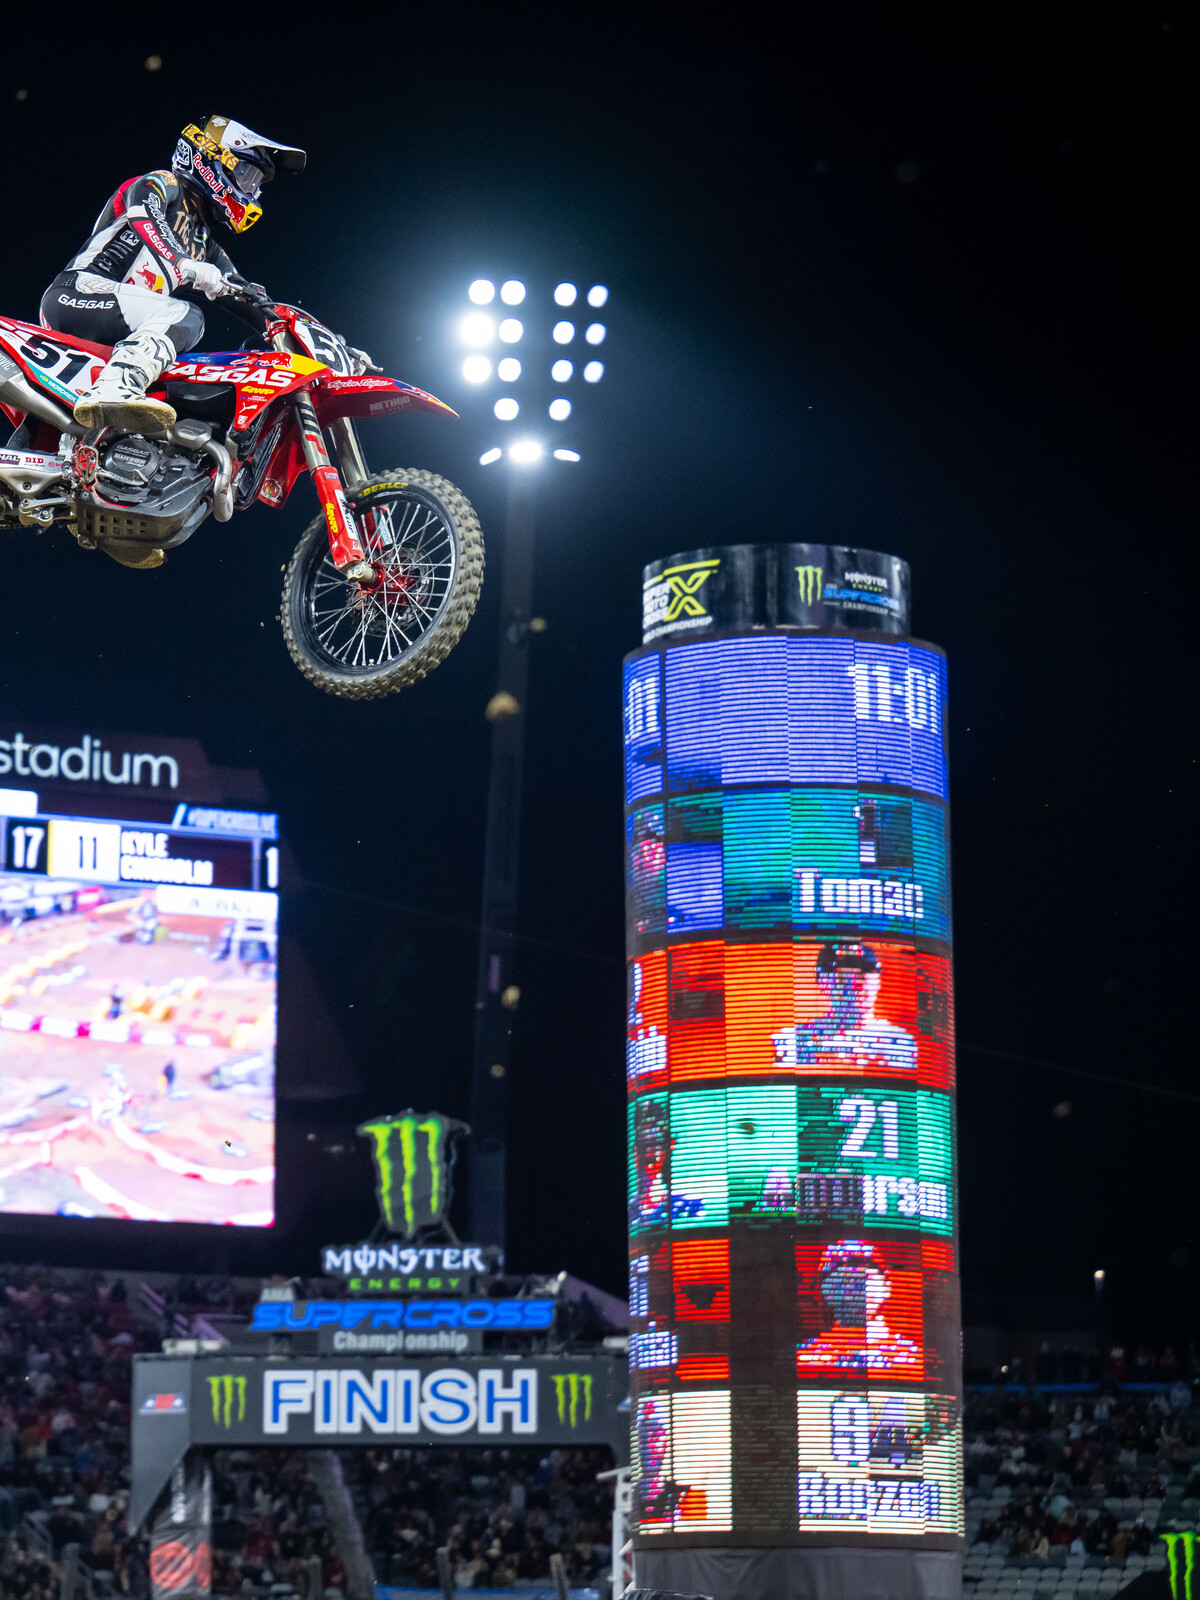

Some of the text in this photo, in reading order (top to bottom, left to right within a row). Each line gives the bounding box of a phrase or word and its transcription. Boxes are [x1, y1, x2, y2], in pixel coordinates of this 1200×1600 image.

[143, 222, 173, 260] GASGAS
[58, 294, 116, 309] GASGAS
[20, 335, 91, 385] 51
[48, 380, 77, 402] MOTOREX
[370, 396, 410, 412] METHOD
[363, 482, 409, 497] DUNLOP
[844, 571, 887, 589] MONSTER
[852, 583, 883, 592] ENERGY
[843, 602, 888, 615] CHAMPIONSHIP
[12, 826, 44, 868] 17
[78, 835, 98, 870] 11
[121, 831, 169, 857] KYLE
[839, 1098, 898, 1159] 21
[323, 1243, 486, 1275] MONSTER
[349, 1277, 461, 1290] ENERGY
[250, 1299, 555, 1331] SUPERCROSS
[333, 1329, 469, 1352] Championship
[263, 1368, 538, 1434] FINISH
[798, 1472, 940, 1519] Roczen
